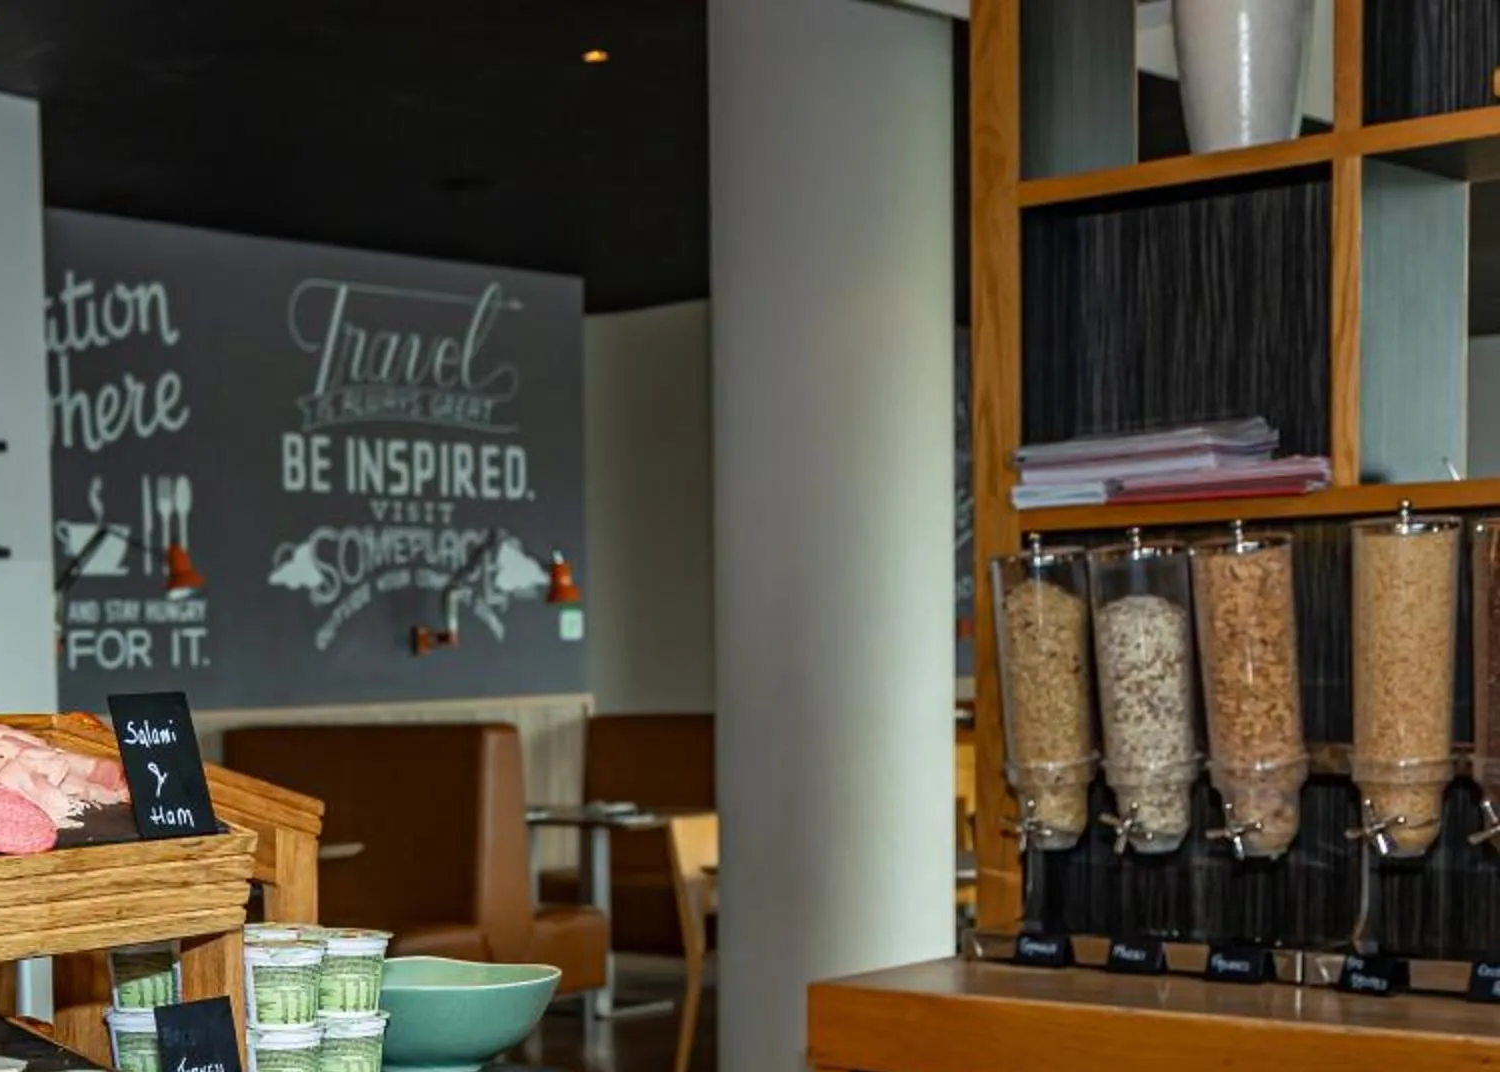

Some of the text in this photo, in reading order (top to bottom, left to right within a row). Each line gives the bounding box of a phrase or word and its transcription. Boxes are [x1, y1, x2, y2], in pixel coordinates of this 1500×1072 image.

[43, 268, 180, 351] tion
[287, 277, 525, 401] Travel
[48, 354, 191, 453] here
[281, 432, 537, 502] BE INSPIRED.
[369, 501, 457, 524] VISIT
[67, 627, 211, 671] FOR IT.
[124, 719, 177, 748] Salami
